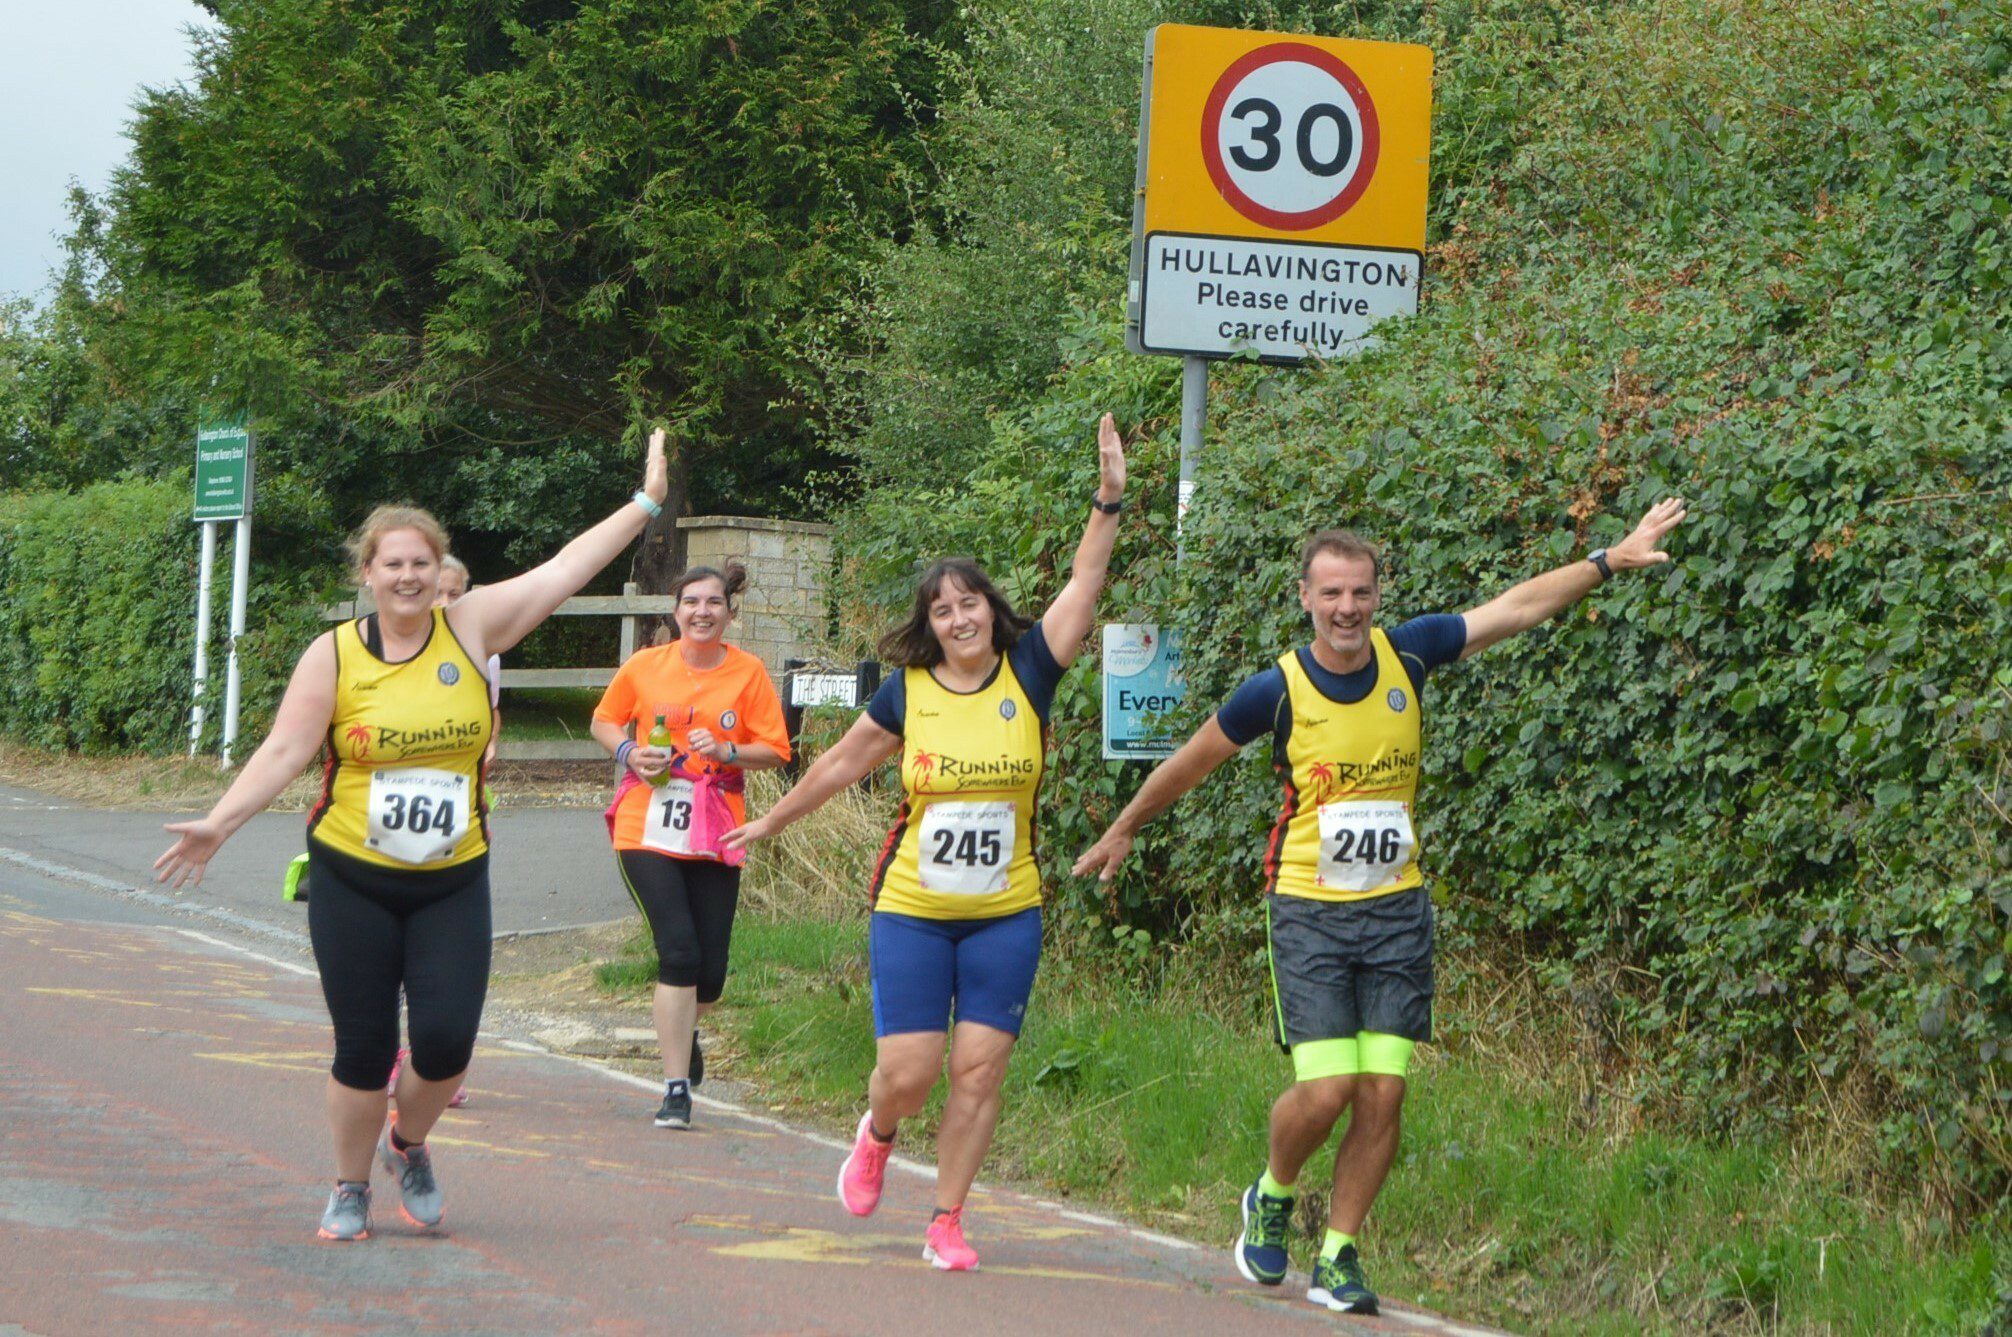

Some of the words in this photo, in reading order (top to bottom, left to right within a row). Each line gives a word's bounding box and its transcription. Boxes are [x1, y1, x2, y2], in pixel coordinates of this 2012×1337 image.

[1229, 97, 1353, 177] 30
[1161, 248, 1407, 287] HULLAVINGTON
[1198, 282, 1288, 311] Please
[1300, 291, 1368, 315] drive
[1218, 319, 1344, 350] carefully
[382, 793, 455, 836] 364
[661, 799, 692, 831] 13
[932, 828, 1001, 867] 245
[1332, 828, 1401, 865] 246
